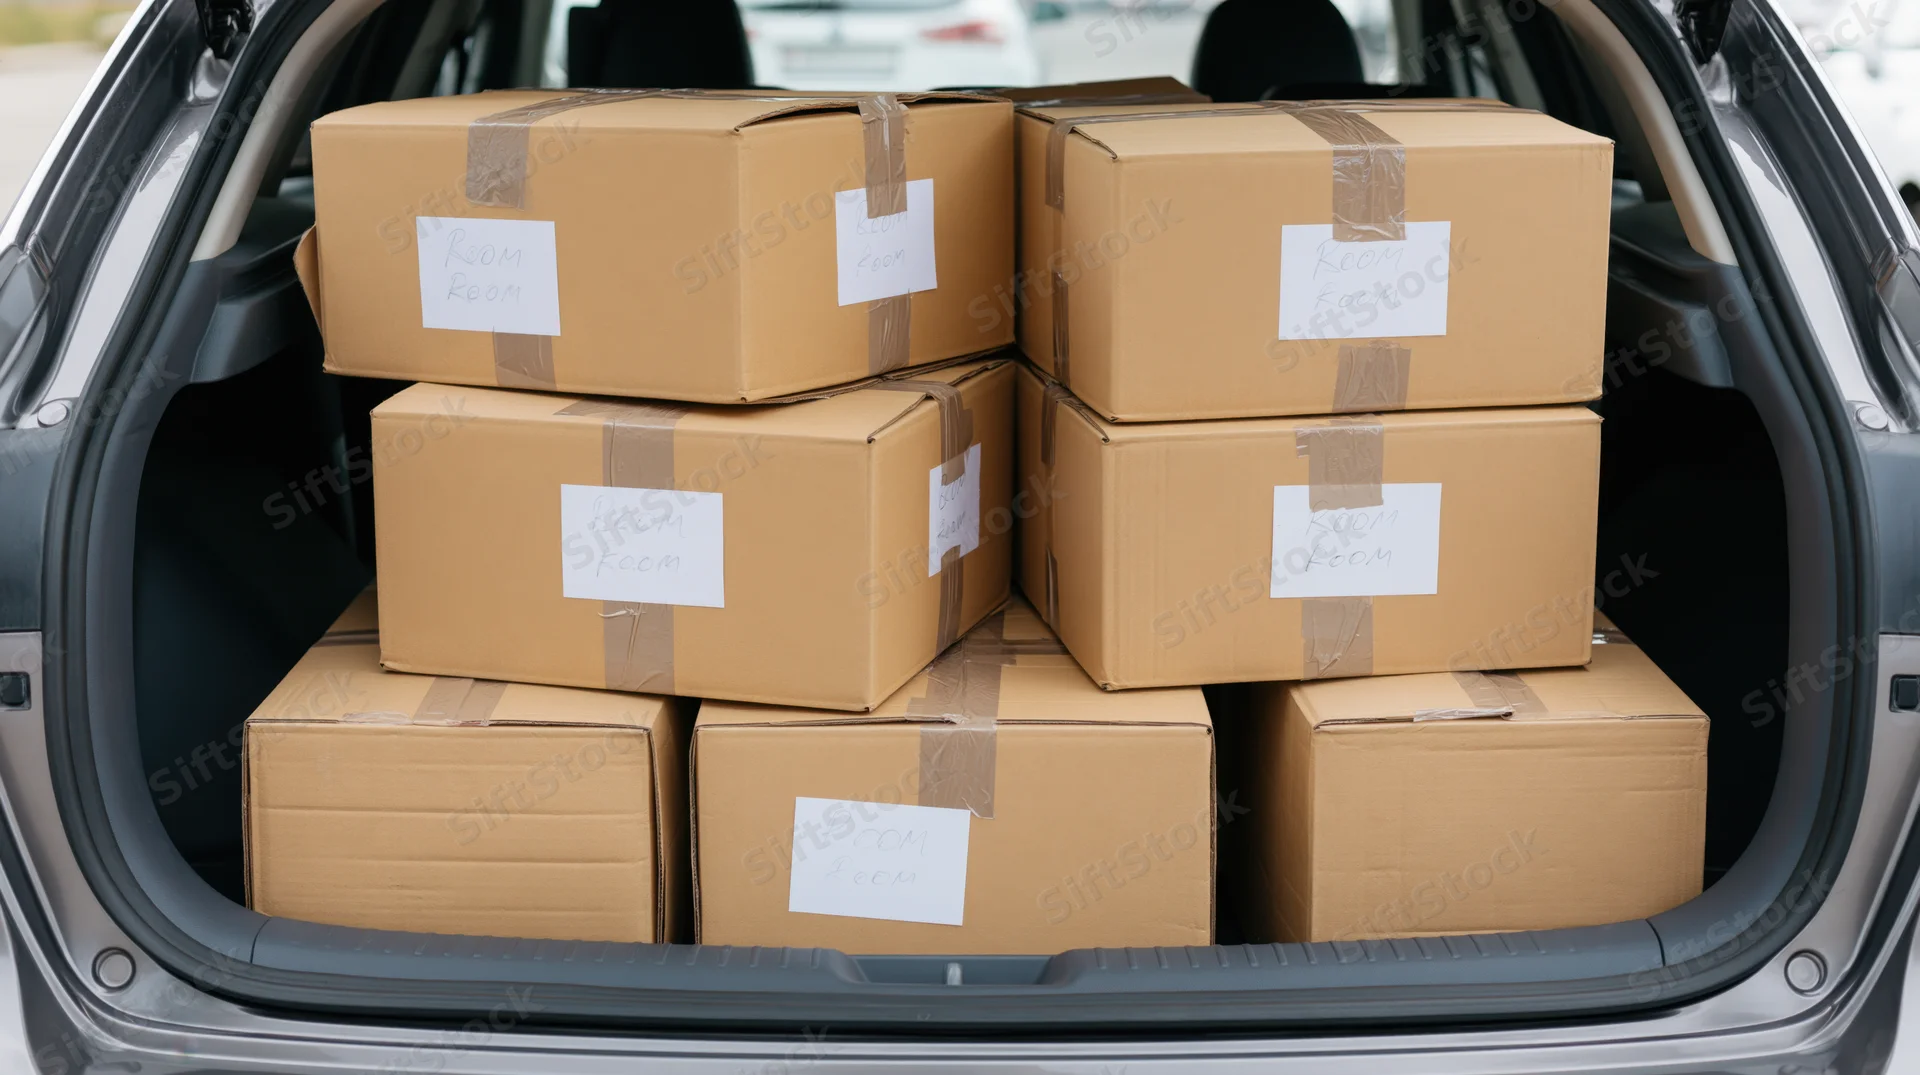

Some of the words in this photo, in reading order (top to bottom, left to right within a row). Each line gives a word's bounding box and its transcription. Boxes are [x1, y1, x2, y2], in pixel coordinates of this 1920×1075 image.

[444, 228, 522, 268] ROOM
[1312, 238, 1404, 281] ROOM
[447, 272, 522, 304] ROOM
[1305, 500, 1399, 535] ROOM
